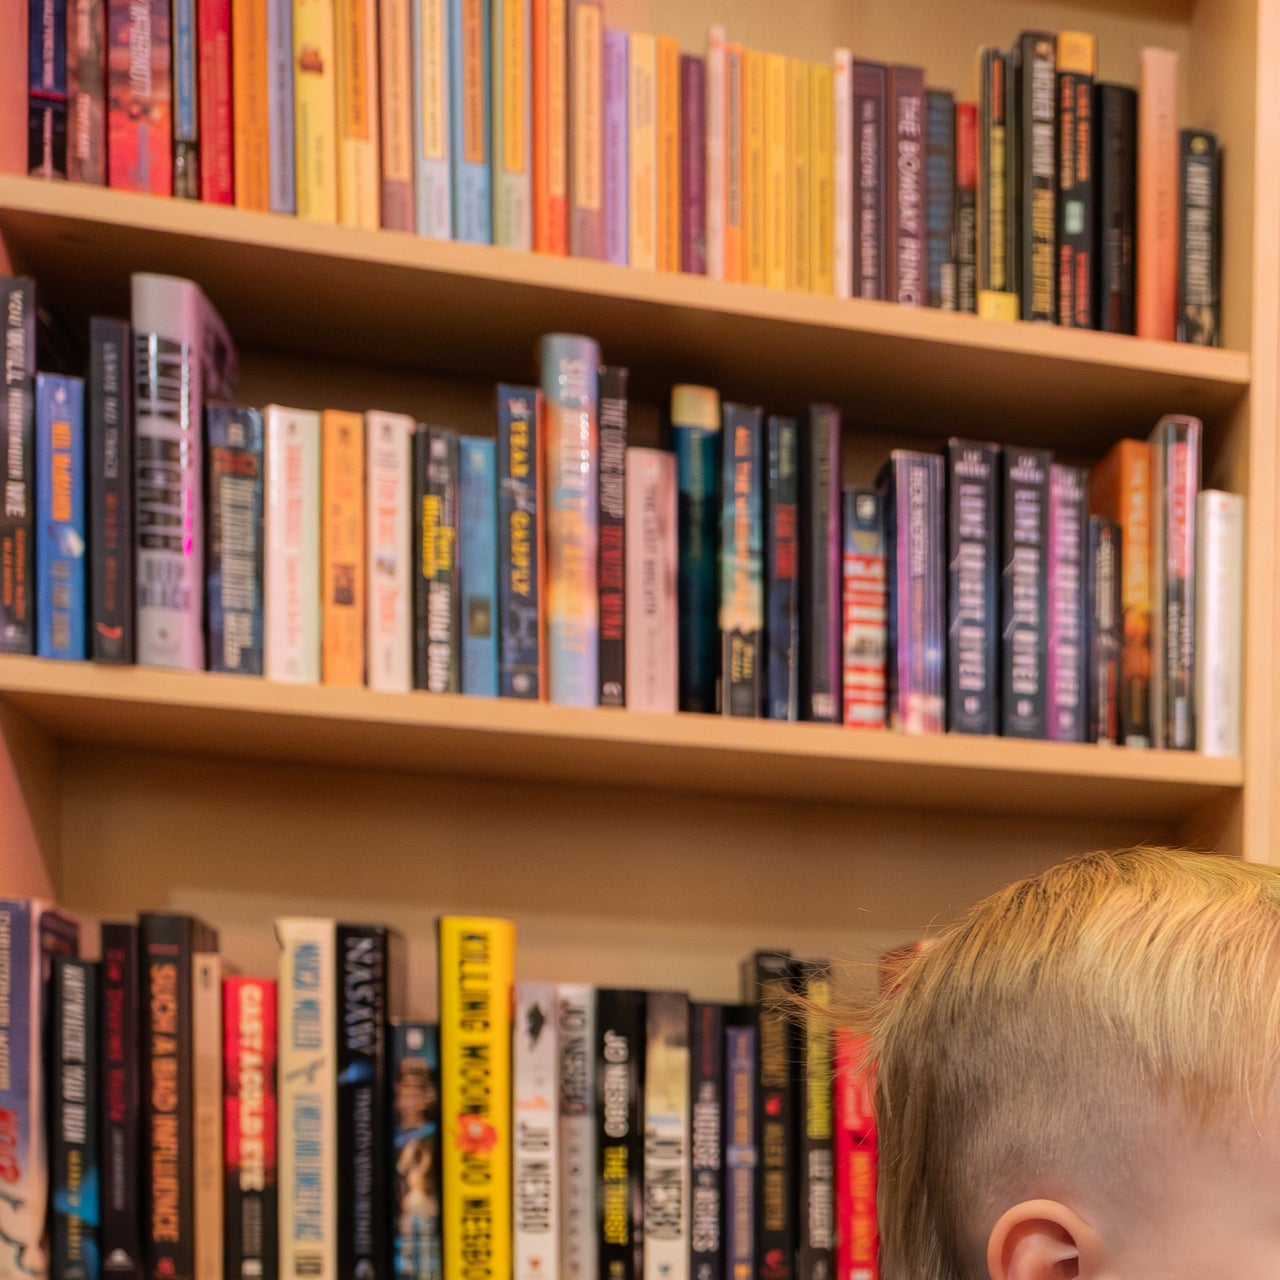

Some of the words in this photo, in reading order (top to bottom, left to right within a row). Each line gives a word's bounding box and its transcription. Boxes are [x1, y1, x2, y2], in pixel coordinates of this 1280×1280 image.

[1032, 60, 1056, 121] ARCHER
[1032, 122, 1056, 177] MAYOR
[1186, 161, 1213, 206] ANDY
[1185, 207, 1213, 307] McDERMOTT
[5, 481, 26, 518] ME
[152, 963, 180, 1034] SUCH
[240, 983, 265, 1050] CAST
[154, 1036, 178, 1055] A
[152, 1056, 180, 1114] BAD
[239, 1071, 264, 1137] COLD
[151, 1115, 180, 1243] INFLUENCE
[239, 1138, 265, 1191] EYE
